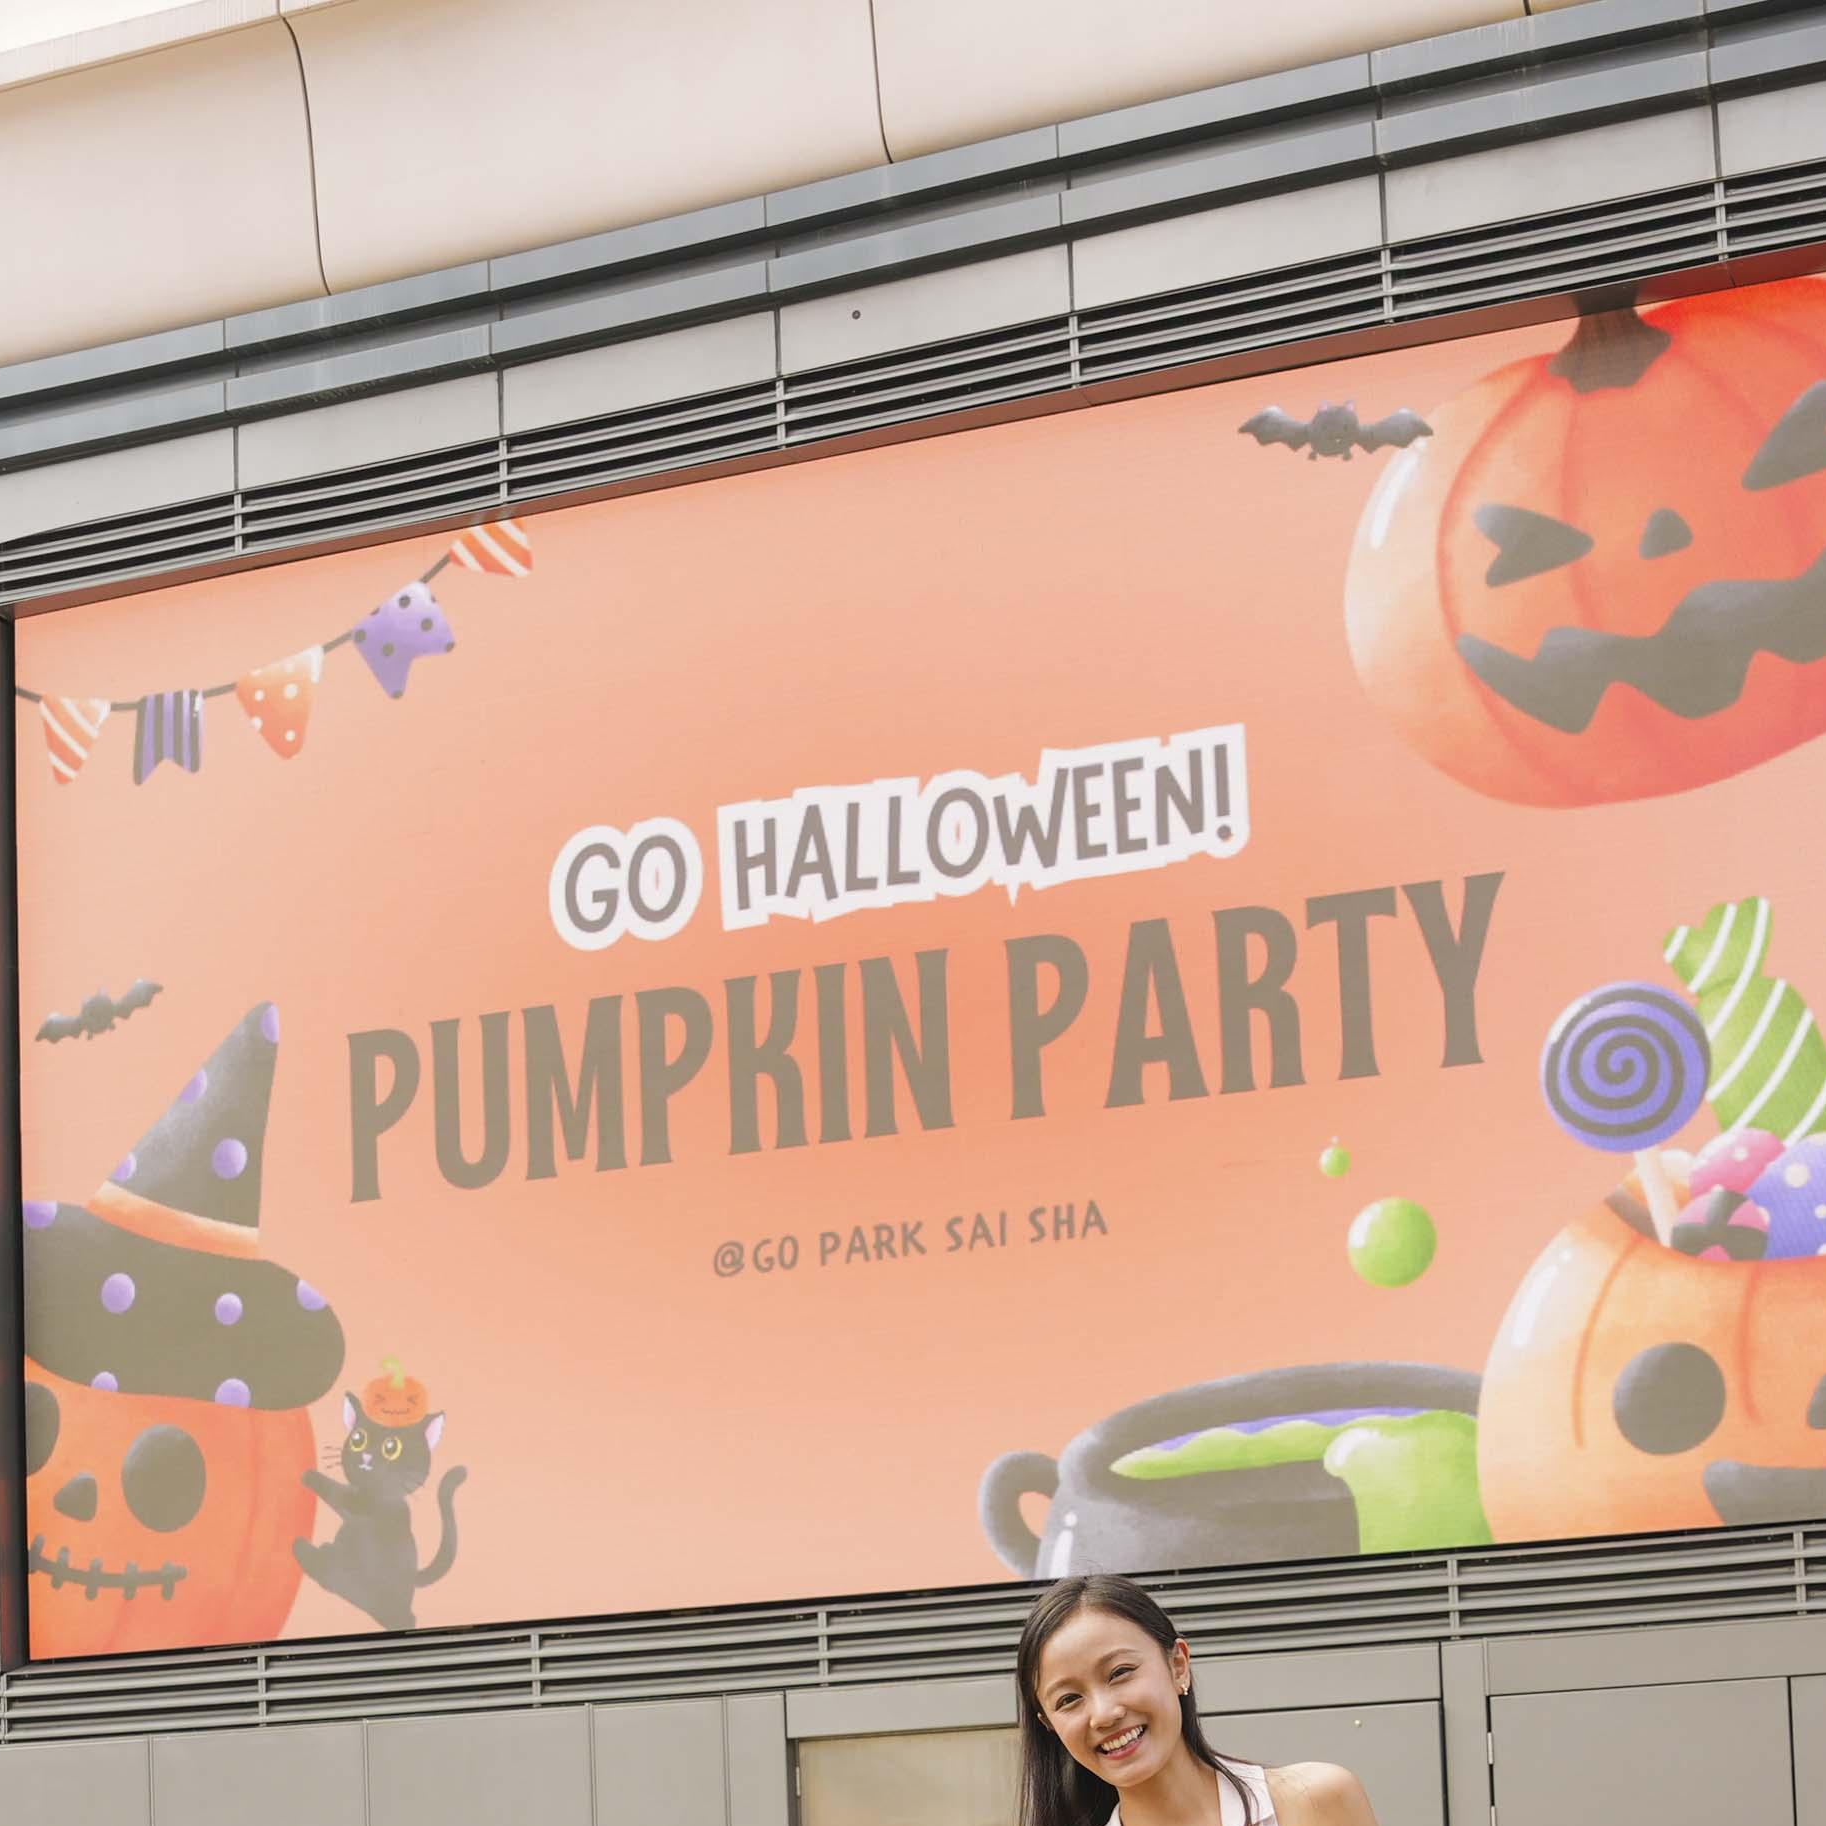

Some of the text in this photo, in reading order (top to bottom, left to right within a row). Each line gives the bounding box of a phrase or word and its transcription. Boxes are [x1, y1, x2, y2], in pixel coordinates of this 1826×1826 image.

[563, 742, 1234, 935] GO HALLOWEEN!
[345, 870, 1507, 1205] PUMPKIN PARTY
[712, 1198, 1110, 1278] @GO PARK SAI SHA
